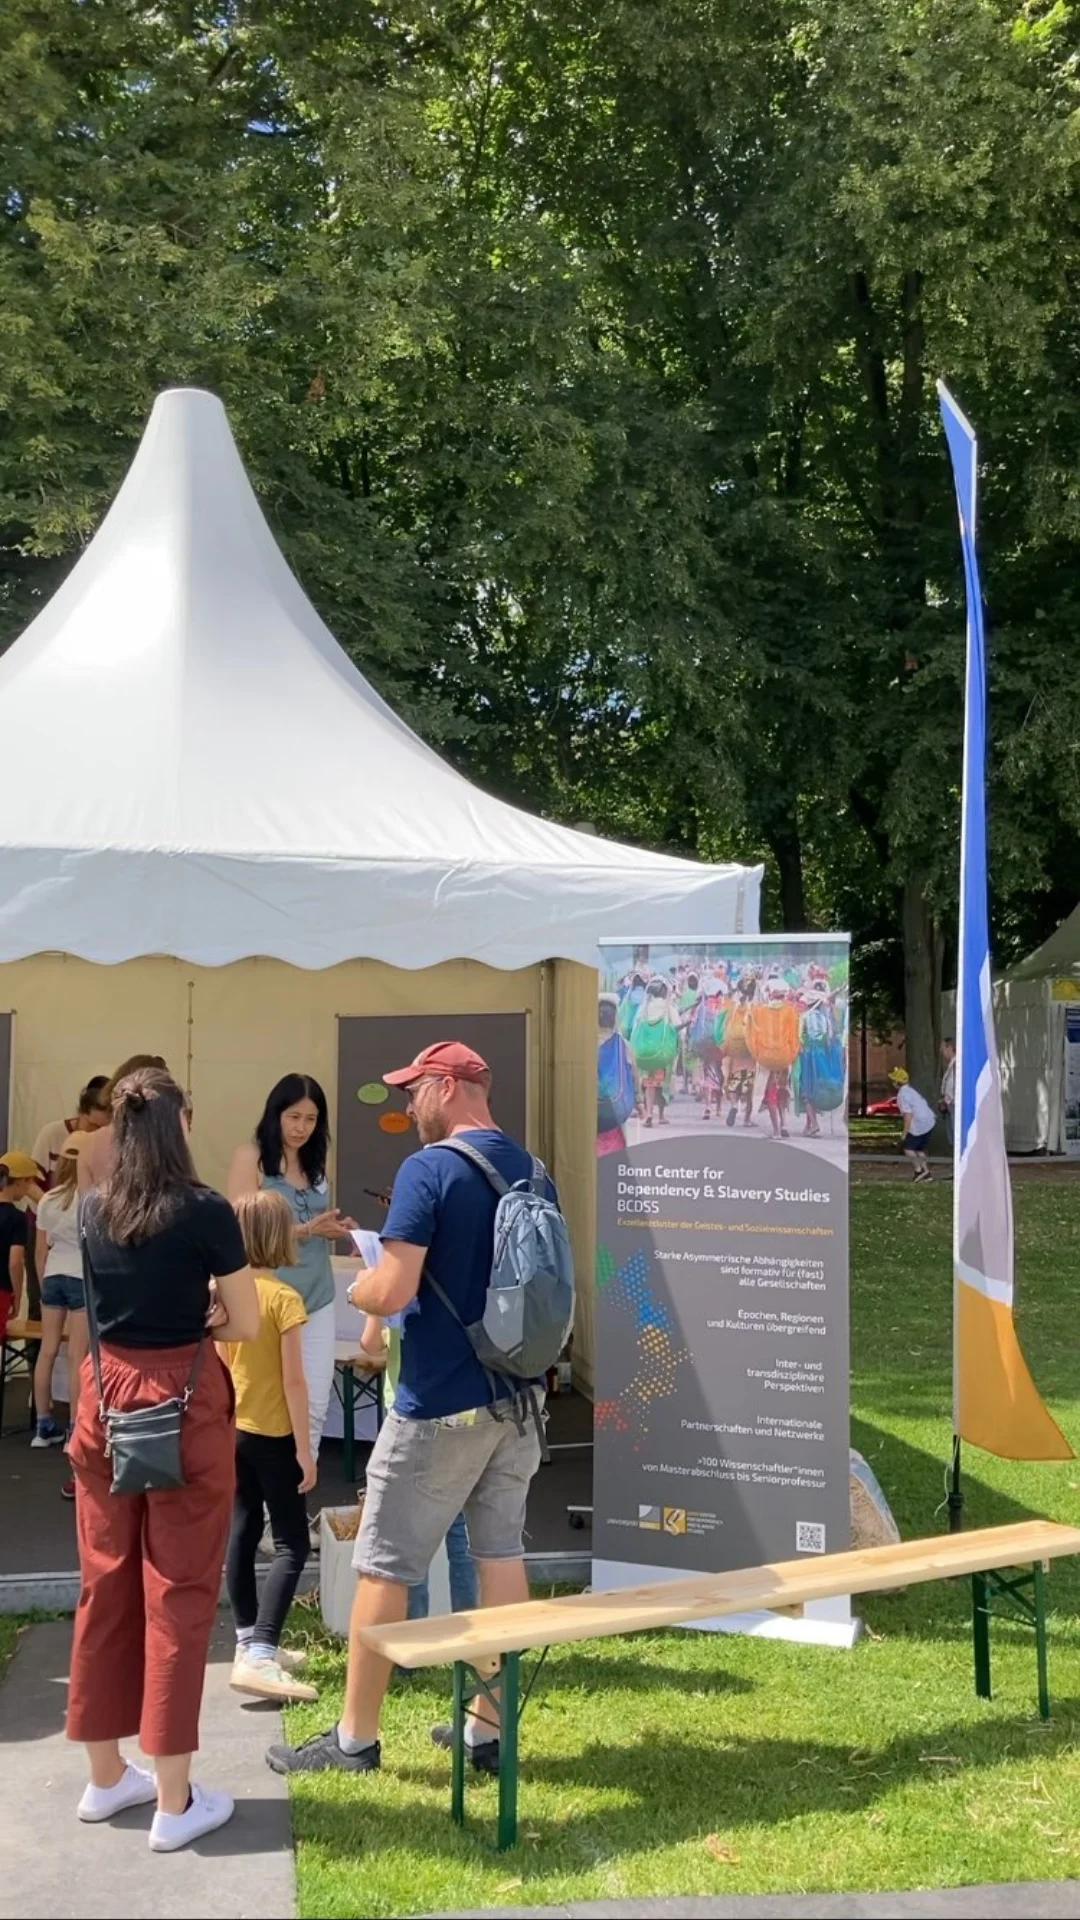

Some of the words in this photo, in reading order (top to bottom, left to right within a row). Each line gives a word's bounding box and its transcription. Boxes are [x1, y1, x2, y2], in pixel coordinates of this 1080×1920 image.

[617, 1163, 652, 1178] Bonn
[654, 1165, 700, 1179] Center
[703, 1166, 724, 1180] for
[617, 1181, 700, 1200] Dependency
[703, 1184, 715, 1198] &
[717, 1185, 772, 1203] Slavery
[774, 1187, 831, 1203] Studies
[616, 1200, 660, 1214] BCDSS
[654, 1249, 682, 1260] Starke
[683, 1251, 751, 1264] Asymmetrische
[752, 1255, 825, 1268] Abhängigkeiten
[720, 1264, 740, 1275] sind
[741, 1265, 781, 1277] formativ
[781, 1267, 796, 1278] für
[797, 1269, 825, 1281] (fast)
[738, 1277, 756, 1287] alle
[757, 1277, 826, 1291] Gesellschaften
[738, 1309, 779, 1321] Epochen,
[780, 1312, 825, 1324] Regionen
[707, 1319, 725, 1328] und
[726, 1319, 765, 1331] Kulturen
[766, 1322, 826, 1336] übergreifend
[775, 1358, 802, 1369] Inter-
[804, 1361, 822, 1371] und
[746, 1367, 825, 1382] transdisziplinäre
[764, 1379, 825, 1394] Perspektiven
[680, 1418, 754, 1436] Partnerschaften
[754, 1427, 773, 1437] und
[774, 1427, 825, 1441] Netzwerke
[756, 1415, 823, 1430] Internationale
[697, 1456, 718, 1467] >100
[641, 1463, 659, 1472] von
[660, 1463, 735, 1480] Masterabschluss
[736, 1471, 751, 1482] bis
[752, 1472, 827, 1488] Seniorprofessur
